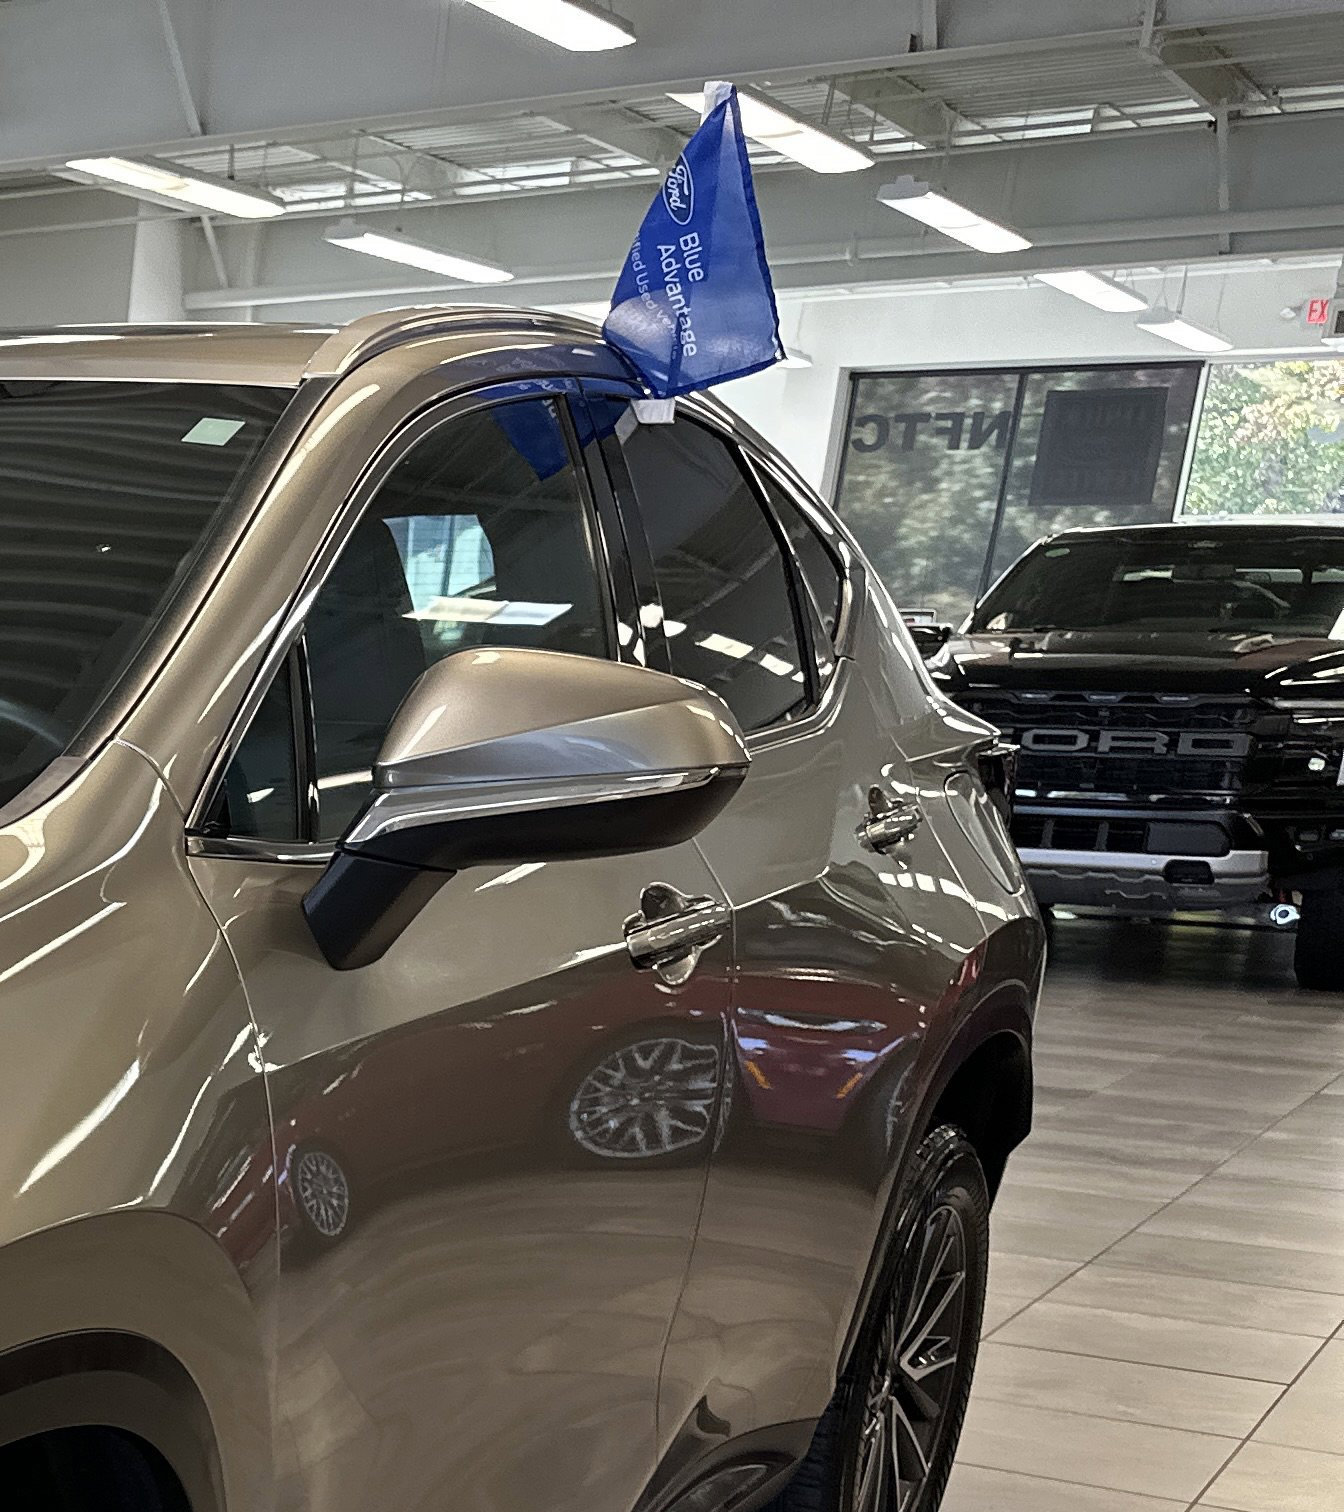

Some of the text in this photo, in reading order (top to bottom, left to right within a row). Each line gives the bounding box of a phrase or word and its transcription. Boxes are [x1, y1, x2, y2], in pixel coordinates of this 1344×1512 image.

[666, 164, 689, 212] Ford
[679, 232, 705, 283] Blue
[636, 272, 658, 310] Used
[657, 244, 697, 358] Advantage
[1307, 299, 1329, 322] EX
[1020, 728, 1254, 756] ORD
